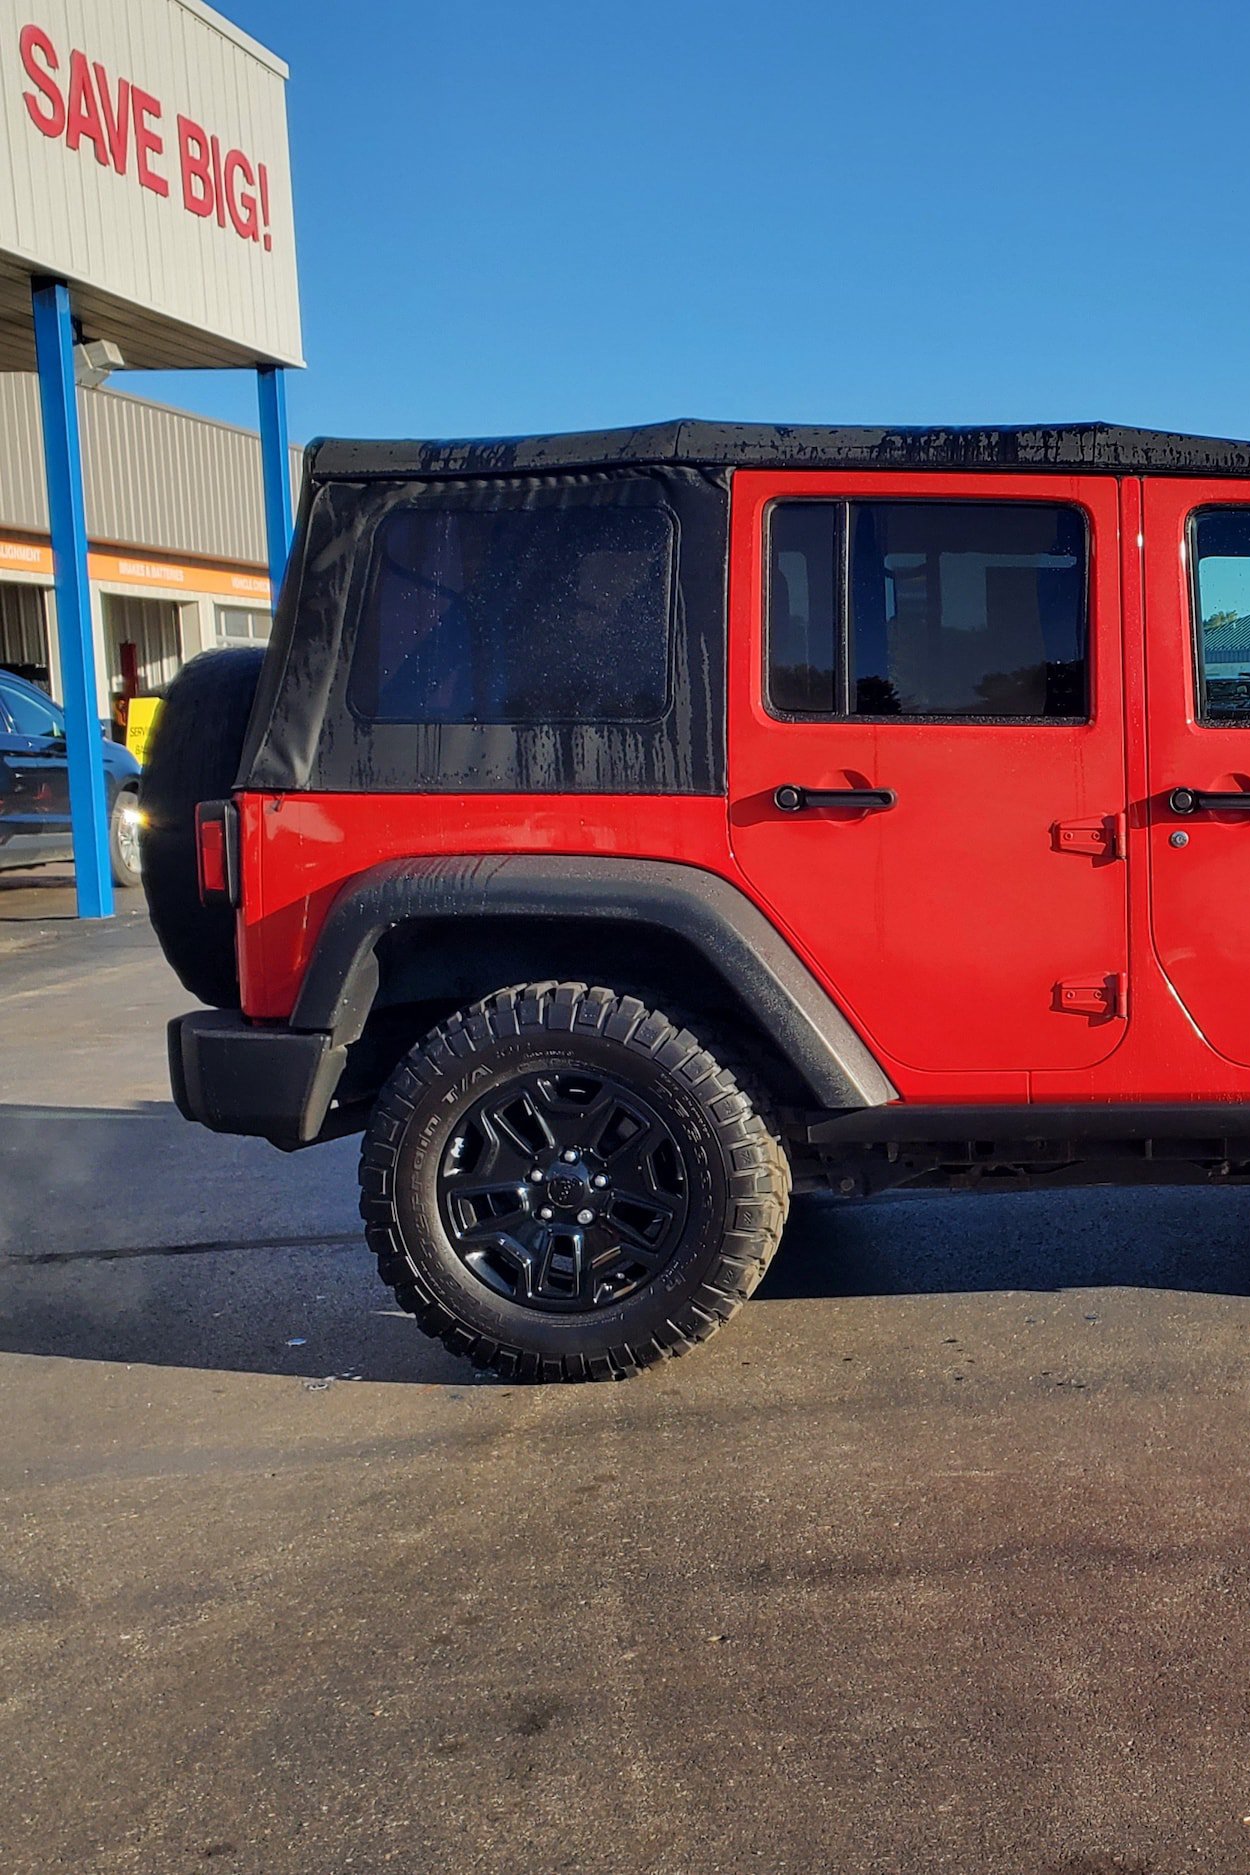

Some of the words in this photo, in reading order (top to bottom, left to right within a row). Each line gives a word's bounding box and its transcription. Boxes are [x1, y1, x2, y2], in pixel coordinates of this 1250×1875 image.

[20, 24, 169, 198] SAVE
[177, 113, 272, 252] BIG!
[441, 1063, 494, 1105] T/A
